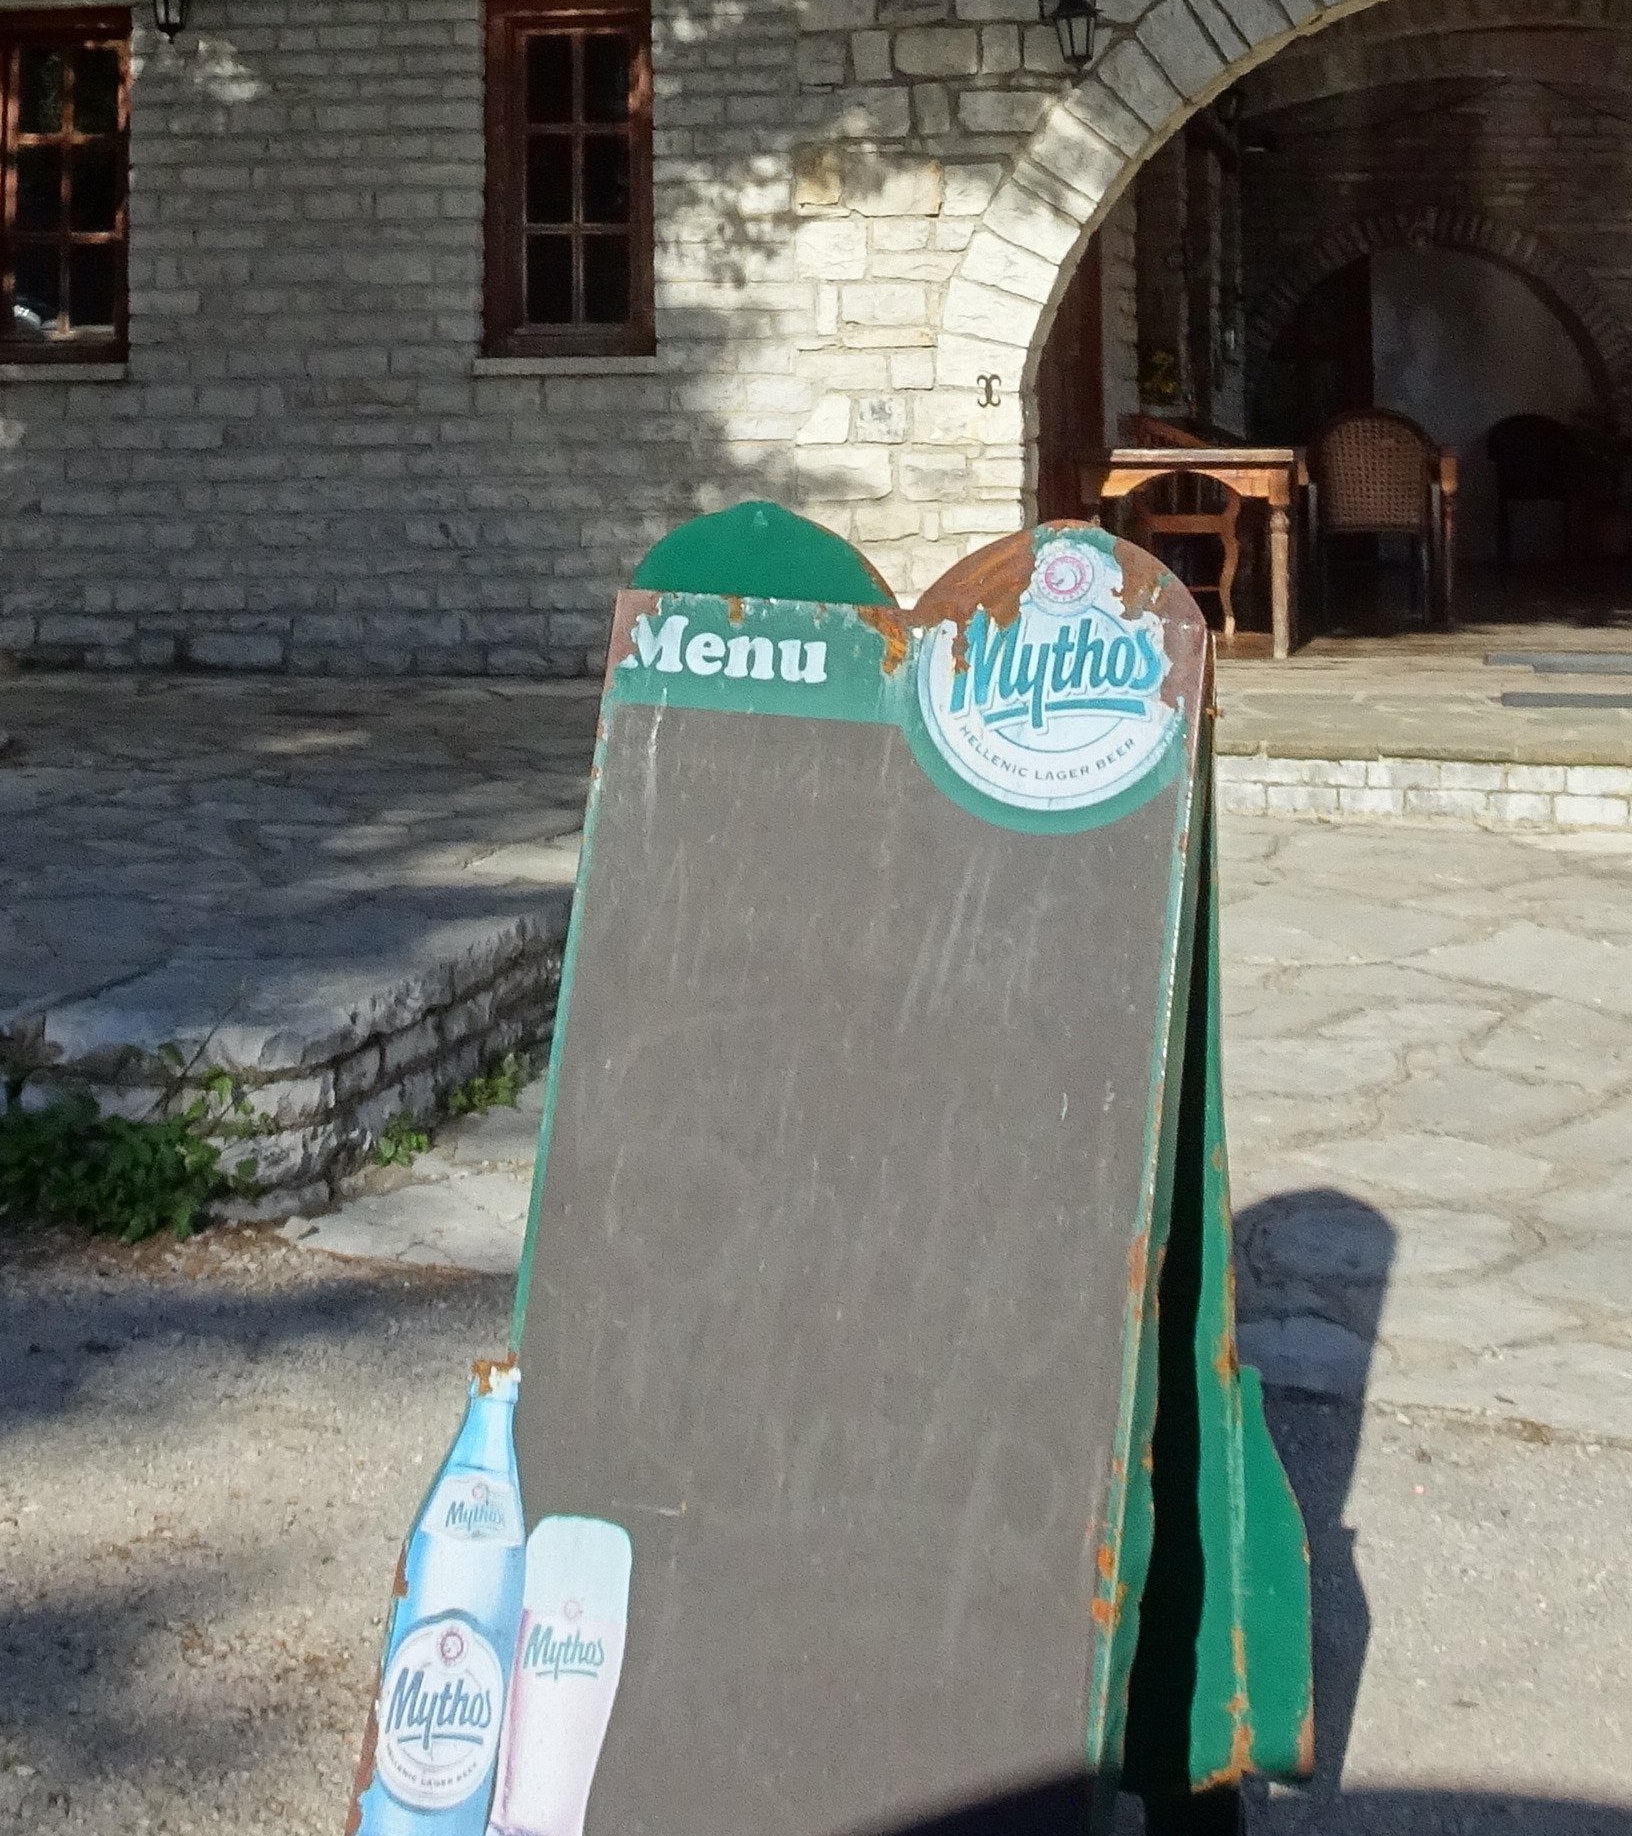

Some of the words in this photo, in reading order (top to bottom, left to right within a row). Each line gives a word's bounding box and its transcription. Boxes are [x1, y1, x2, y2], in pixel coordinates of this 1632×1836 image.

[620, 612, 828, 684] Menu
[949, 609, 1162, 729] Mythos
[959, 722, 1030, 779] HELLENIC
[1034, 765, 1091, 781] LAGER
[1095, 736, 1137, 772] BEER
[523, 1623, 605, 1683] Mythos
[385, 1667, 492, 1751] Mythos
